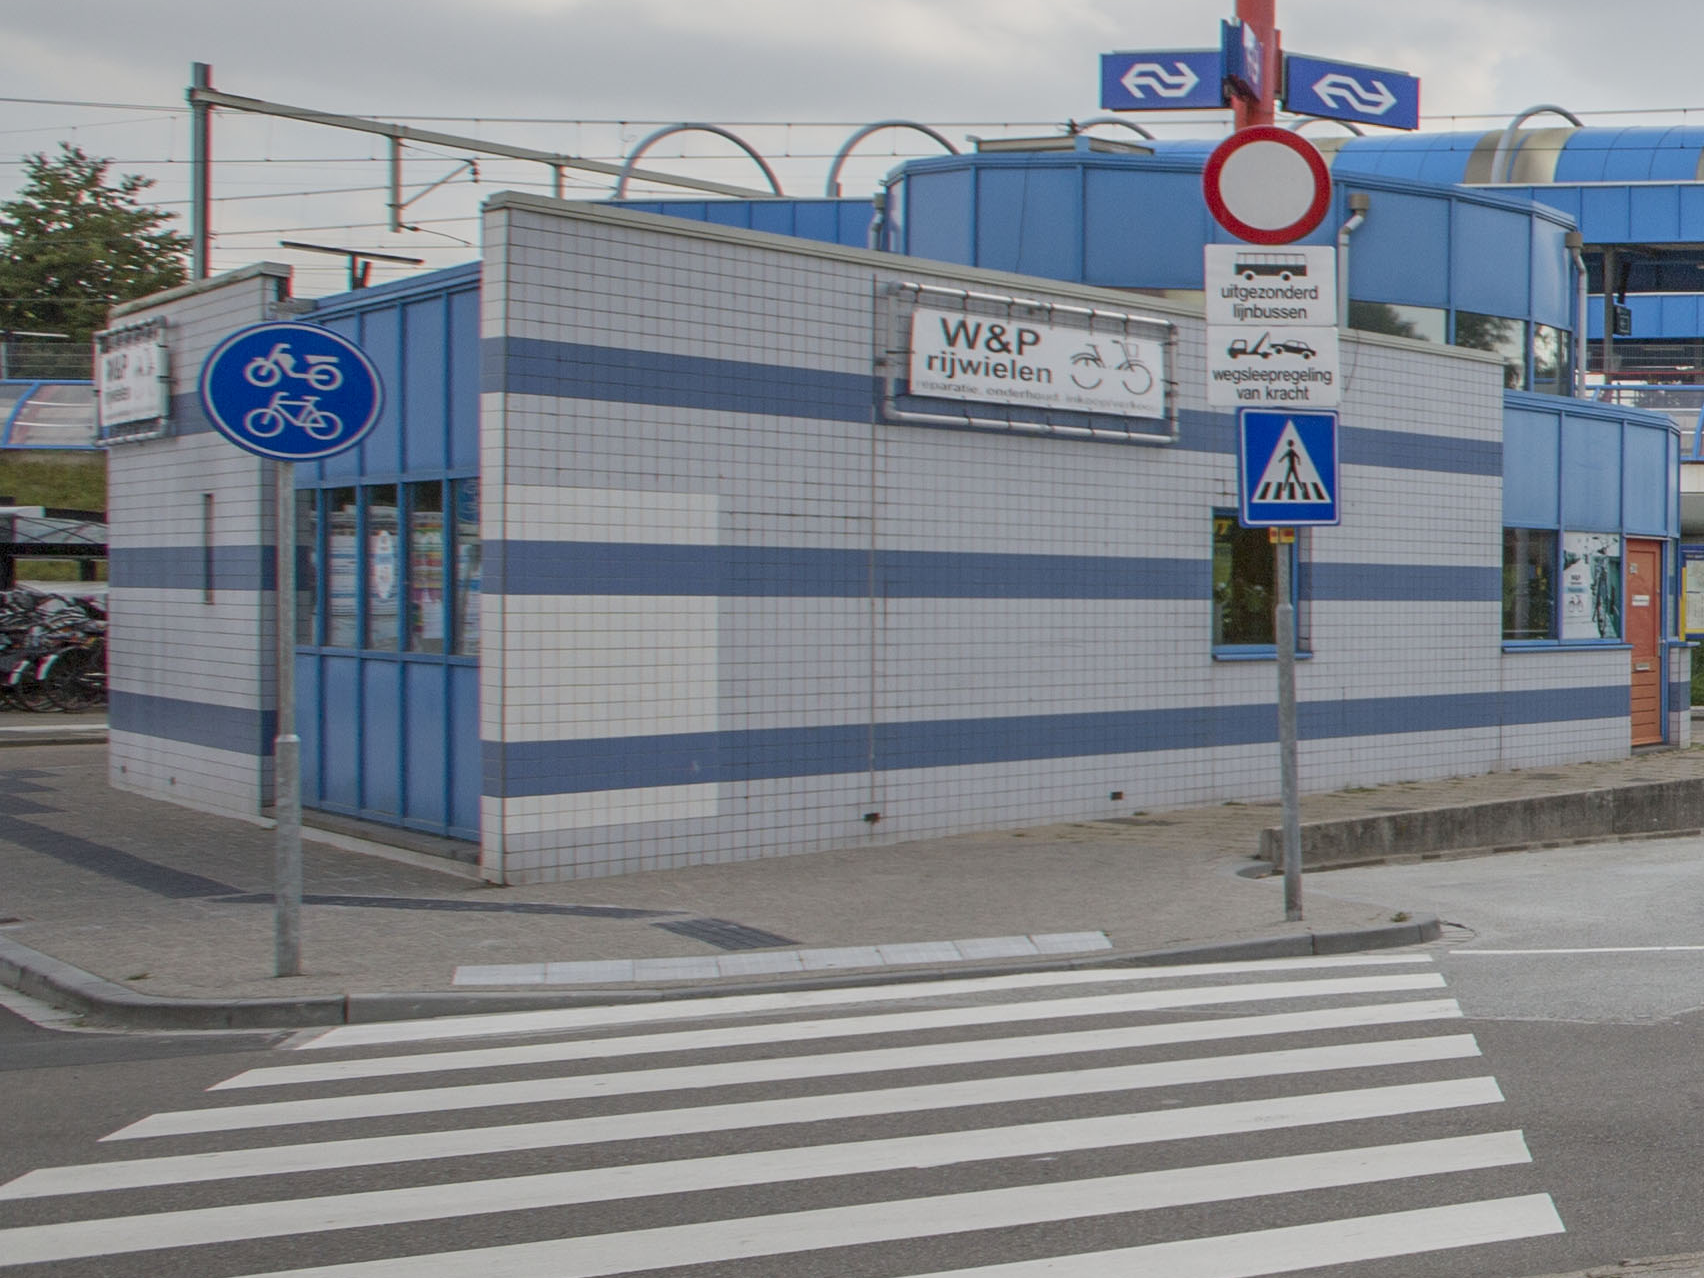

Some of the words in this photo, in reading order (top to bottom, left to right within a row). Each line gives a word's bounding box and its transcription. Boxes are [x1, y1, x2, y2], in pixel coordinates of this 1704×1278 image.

[1221, 284, 1319, 302] uitgezonderd
[1233, 304, 1307, 321] lijnbussen
[940, 317, 1041, 356] W&P
[926, 350, 1052, 384] rijwielen
[1212, 367, 1333, 386] wegsleepregeling
[1236, 388, 1260, 401] van
[1266, 386, 1309, 401] kracht
